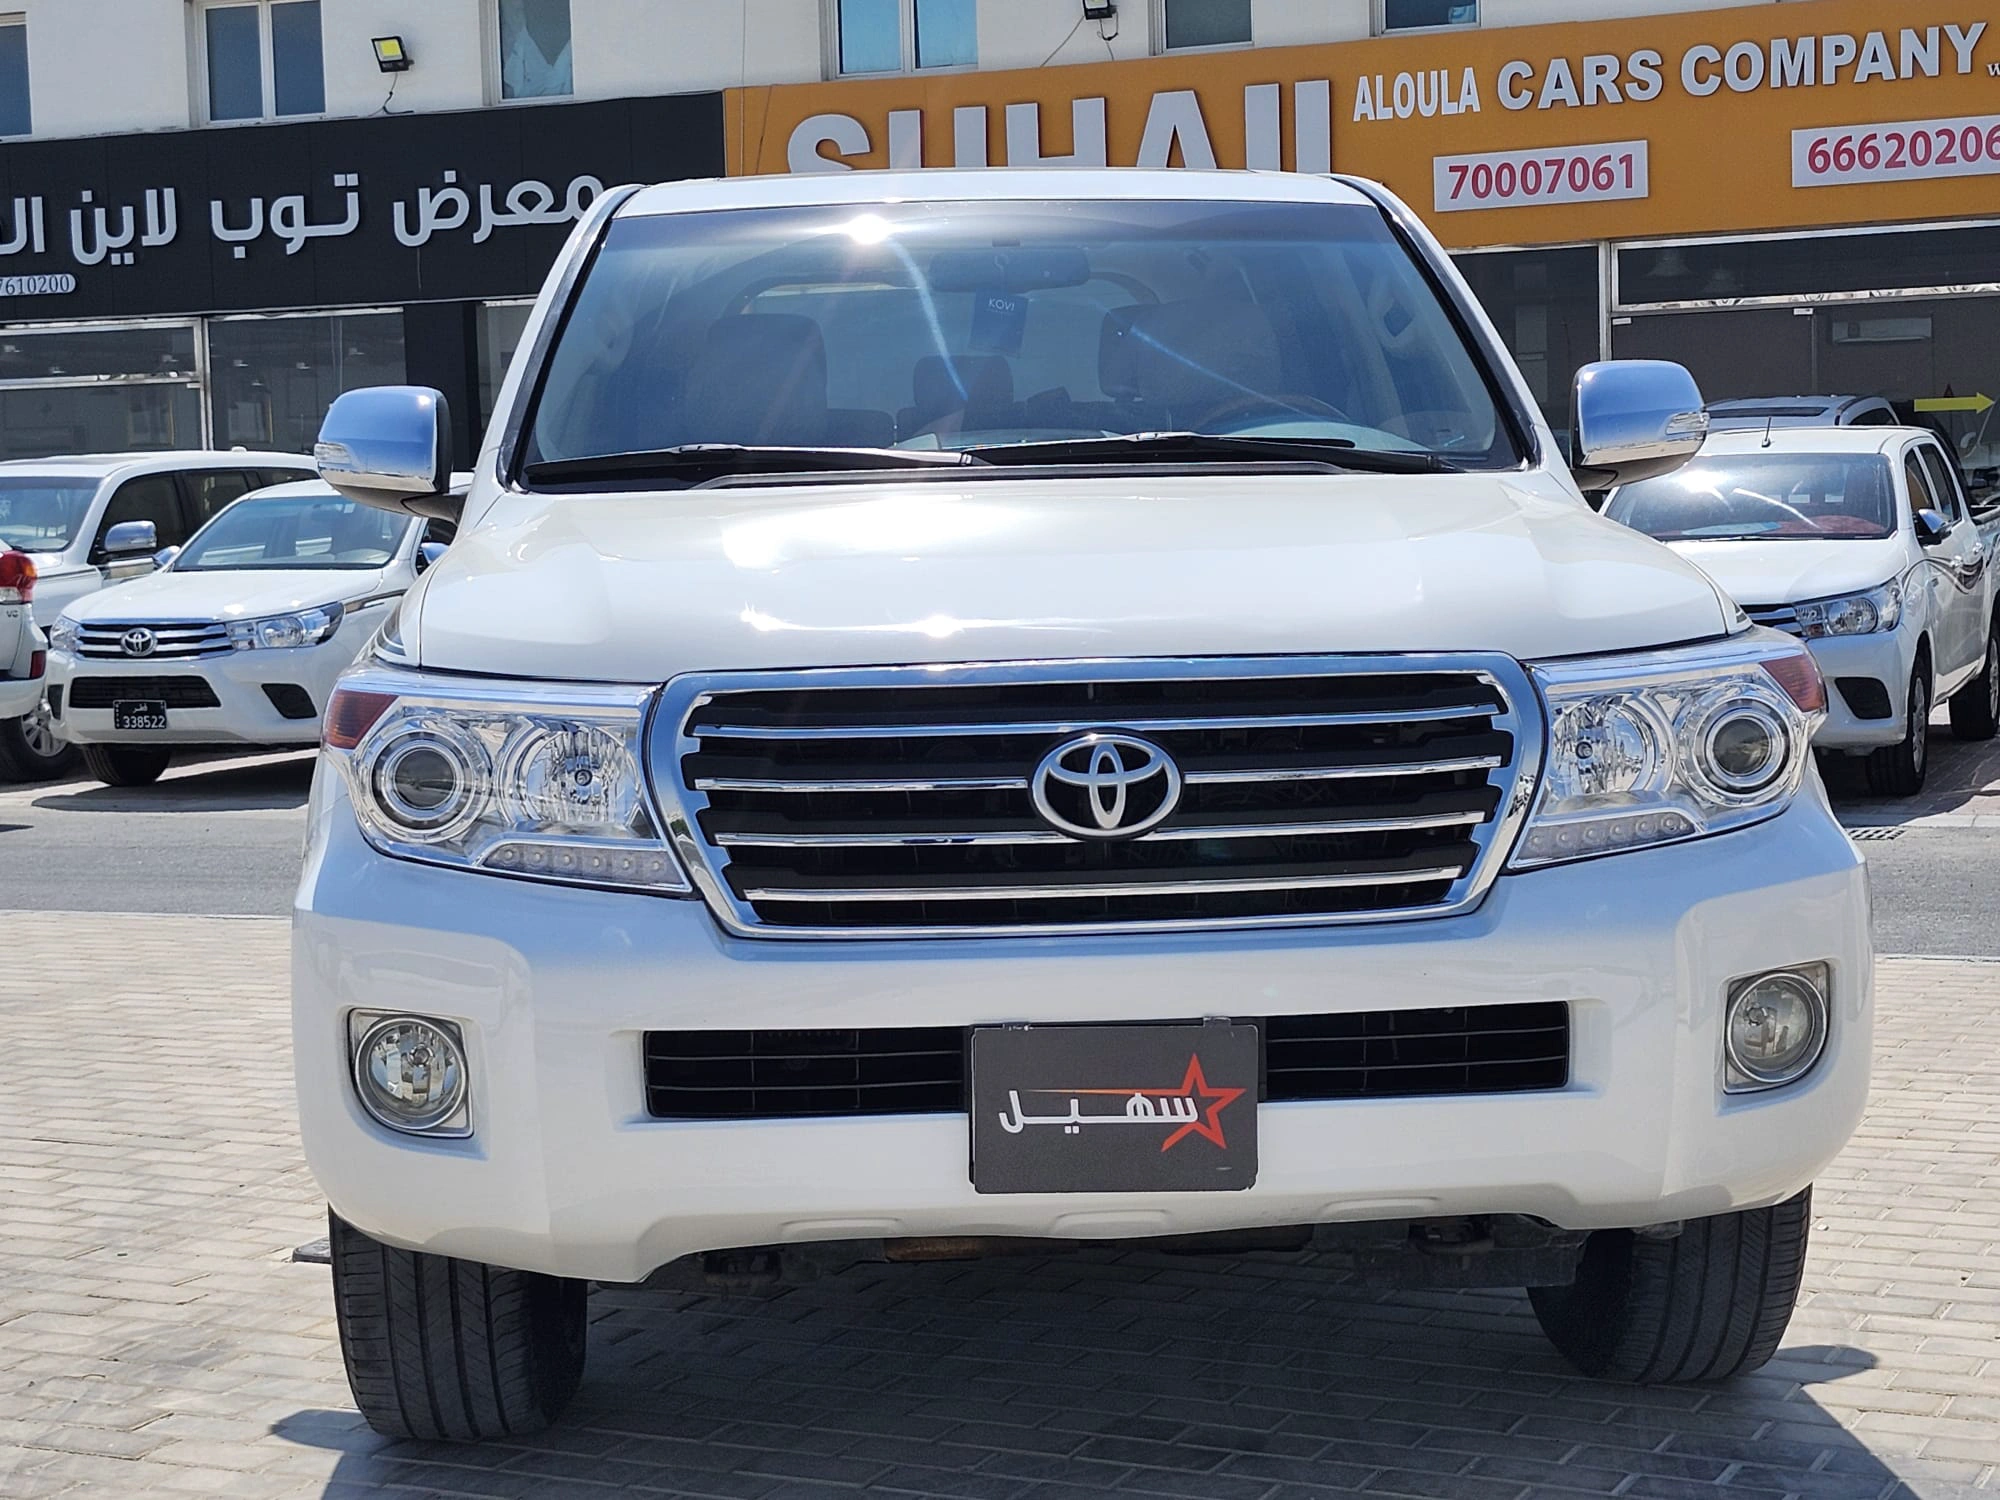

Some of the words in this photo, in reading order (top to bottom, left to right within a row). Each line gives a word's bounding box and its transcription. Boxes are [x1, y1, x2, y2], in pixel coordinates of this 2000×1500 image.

[1353, 67, 1480, 122] ALOULA
[1497, 50, 1663, 110] CARS
[1681, 22, 1987, 97] COMPANY
[1448, 153, 1634, 200] 70007061
[1807, 124, 2000, 174] 66620206
[70, 187, 178, 266] لاين
[210, 173, 360, 259] توب
[393, 170, 604, 247] معرض
[123, 714, 166, 729] 338522
[998, 1090, 1199, 1135] سهيل
